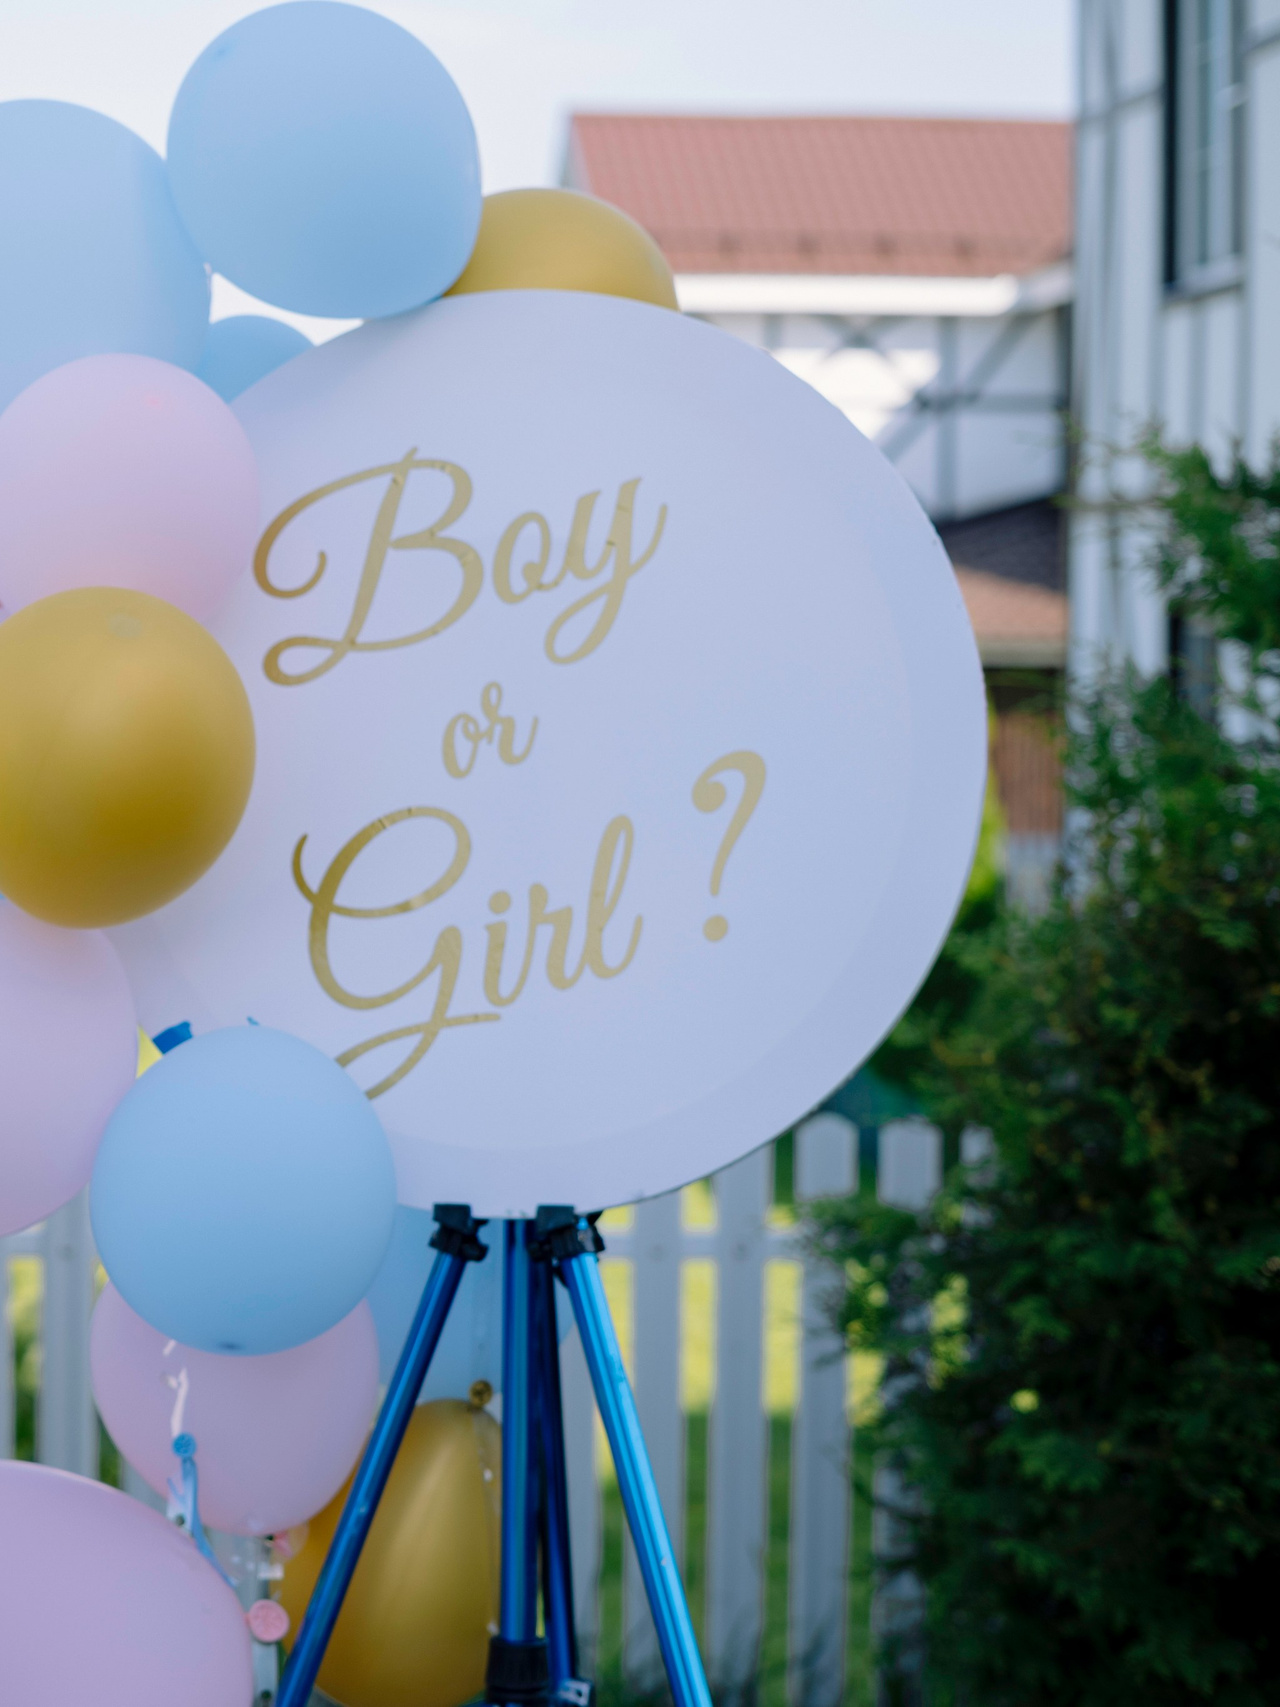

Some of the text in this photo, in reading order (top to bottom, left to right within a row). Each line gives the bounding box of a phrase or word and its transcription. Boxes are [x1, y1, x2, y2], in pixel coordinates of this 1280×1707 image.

[252, 448, 667, 686] Boy
[442, 682, 538, 779] or
[292, 751, 766, 1099] Girl ?
